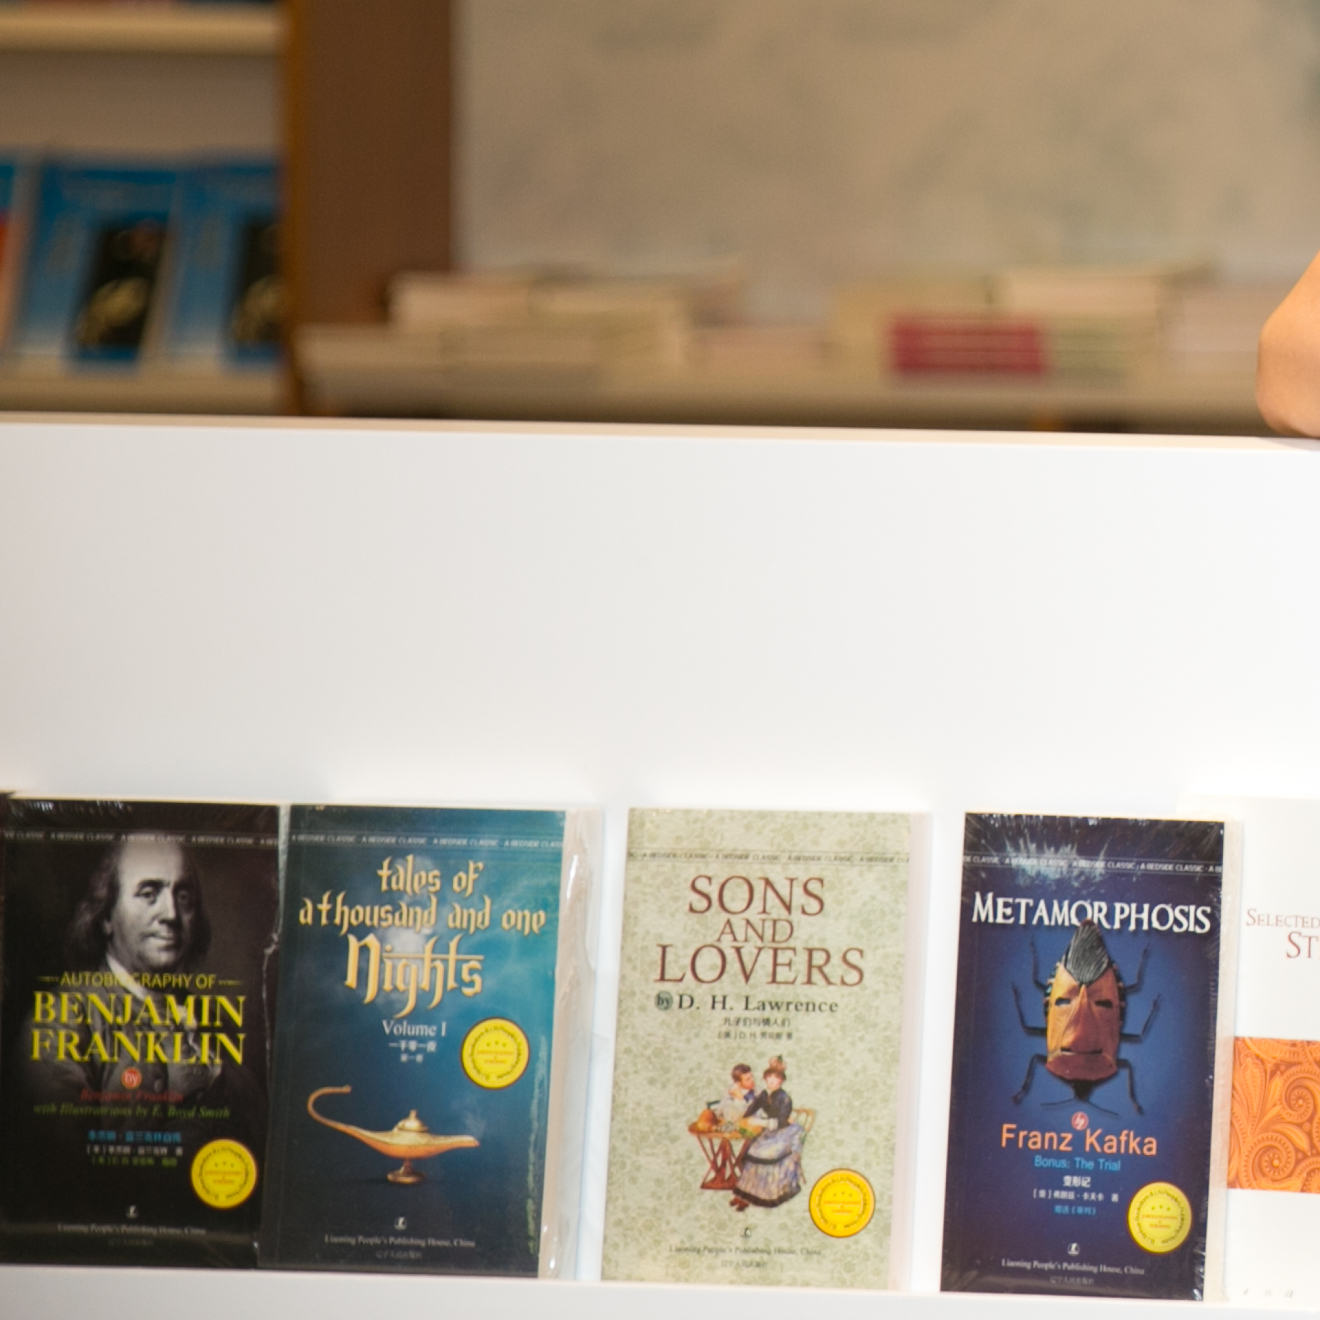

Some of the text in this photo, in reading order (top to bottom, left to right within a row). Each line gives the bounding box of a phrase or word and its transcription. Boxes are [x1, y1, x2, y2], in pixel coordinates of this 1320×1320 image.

[376, 854, 484, 898] tales of
[973, 854, 1000, 865] CLASSIC
[1078, 858, 1106, 869] BEDSIDE
[1107, 860, 1134, 870] CLASSIC
[1140, 861, 1146, 870] A
[1146, 861, 1174, 872] BEDSIDE
[1176, 862, 1204, 873] CLASSIC
[688, 874, 825, 917] SONS
[447, 894, 492, 936] and
[501, 908, 546, 937] one
[971, 891, 1211, 933] METAMORPHOSIS
[715, 917, 794, 944] AND
[344, 932, 485, 1020] Nights
[654, 943, 865, 987] LOVERS
[60, 972, 217, 989] AUTOBIOGRAPHY OF
[33, 990, 246, 1028] BENJAMIN
[655, 994, 838, 1013] by D. H. Lawrence
[382, 1019, 437, 1036] Volume
[30, 1028, 246, 1066] FRANKLIN
[124, 1071, 138, 1086] by
[1001, 1124, 1158, 1156] Franz Kafka
[1034, 1155, 1121, 1171] Bonus: The Trial
[1062, 1175, 1092, 1188] 变形记
[1033, 1260, 1060, 1271] People's
[1062, 1262, 1098, 1274] Publishing
[1100, 1264, 1122, 1274] House,
[1124, 1265, 1145, 1274] China
